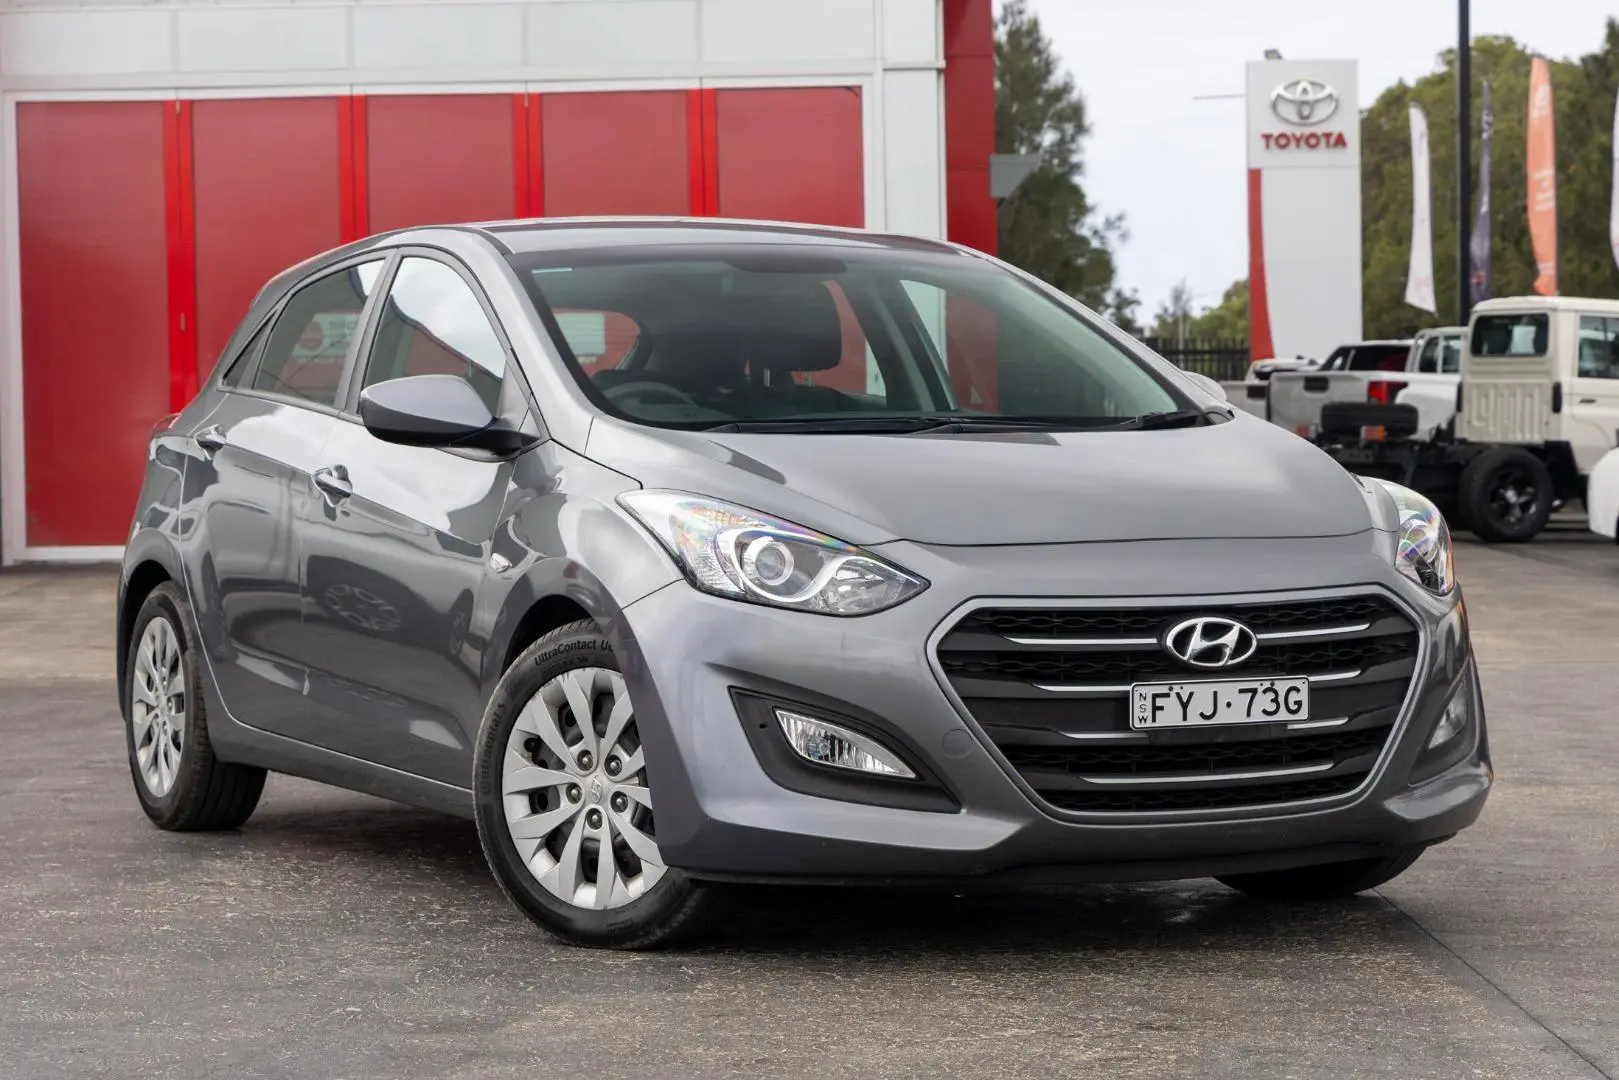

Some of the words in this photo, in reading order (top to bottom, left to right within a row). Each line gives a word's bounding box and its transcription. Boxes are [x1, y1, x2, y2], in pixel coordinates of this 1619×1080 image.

[1261, 131, 1347, 150] TOYOTA
[534, 639, 597, 666] UltraContact
[1137, 692, 1149, 724] NSW
